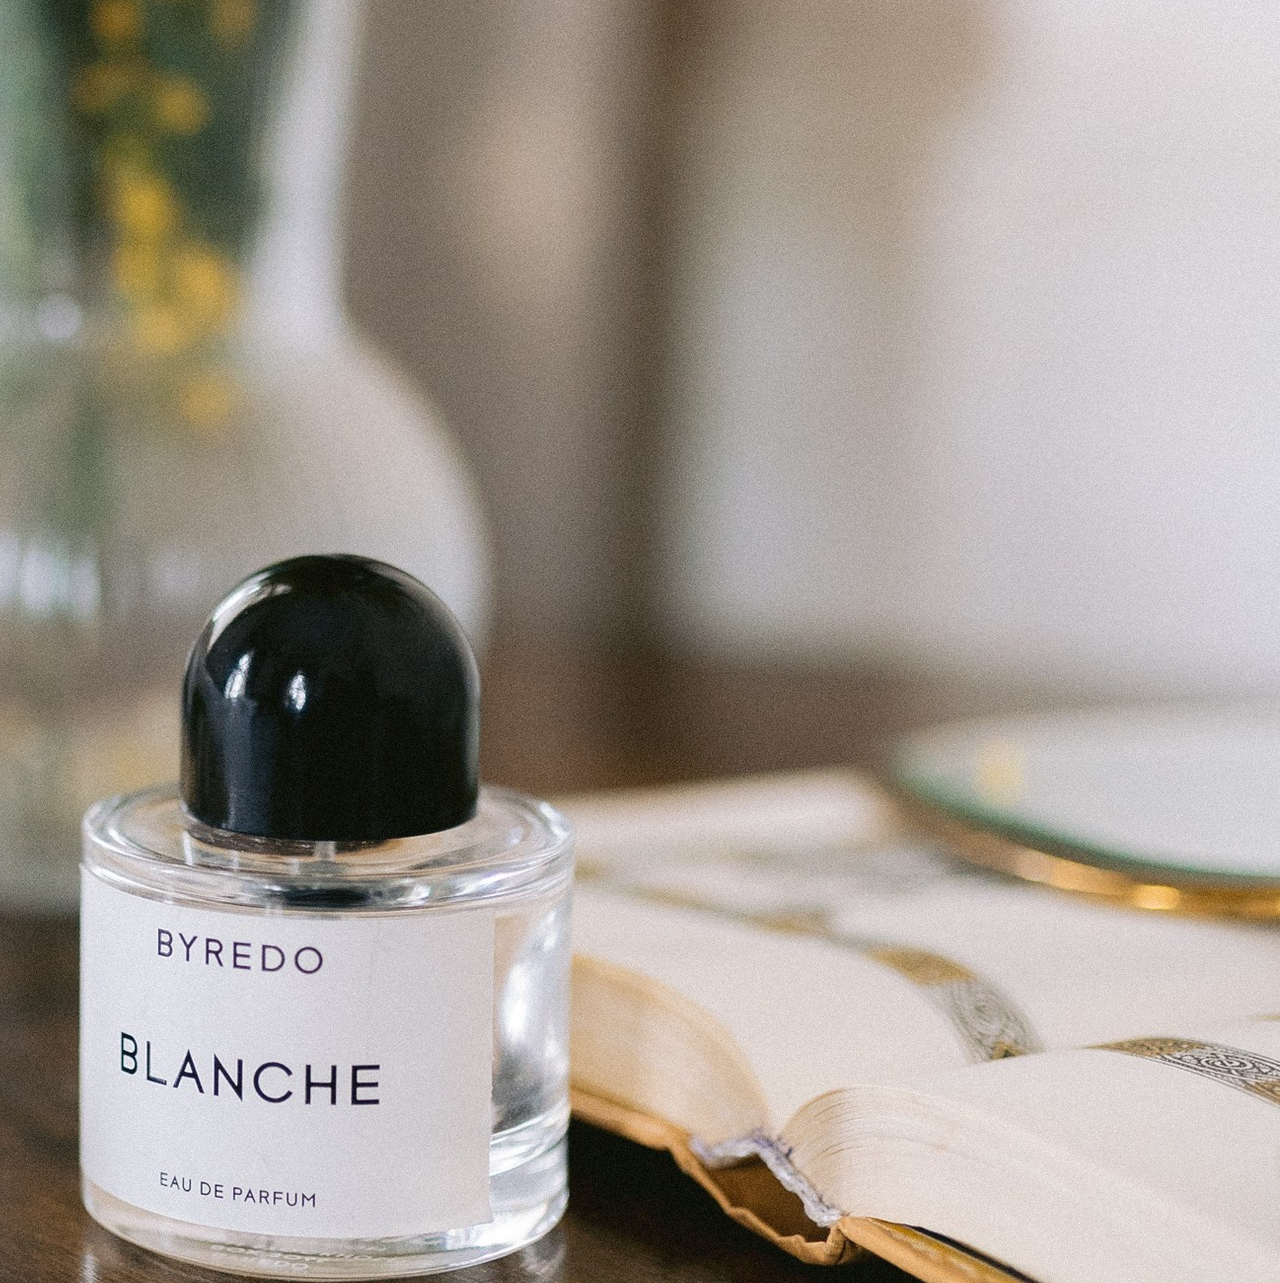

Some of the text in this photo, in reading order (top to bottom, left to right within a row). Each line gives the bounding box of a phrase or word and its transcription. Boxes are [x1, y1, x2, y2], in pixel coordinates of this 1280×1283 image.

[157, 927, 324, 975] BYREDO
[120, 1031, 381, 1106] BLANCHE
[159, 1171, 316, 1208] EAU DE PARFUM
